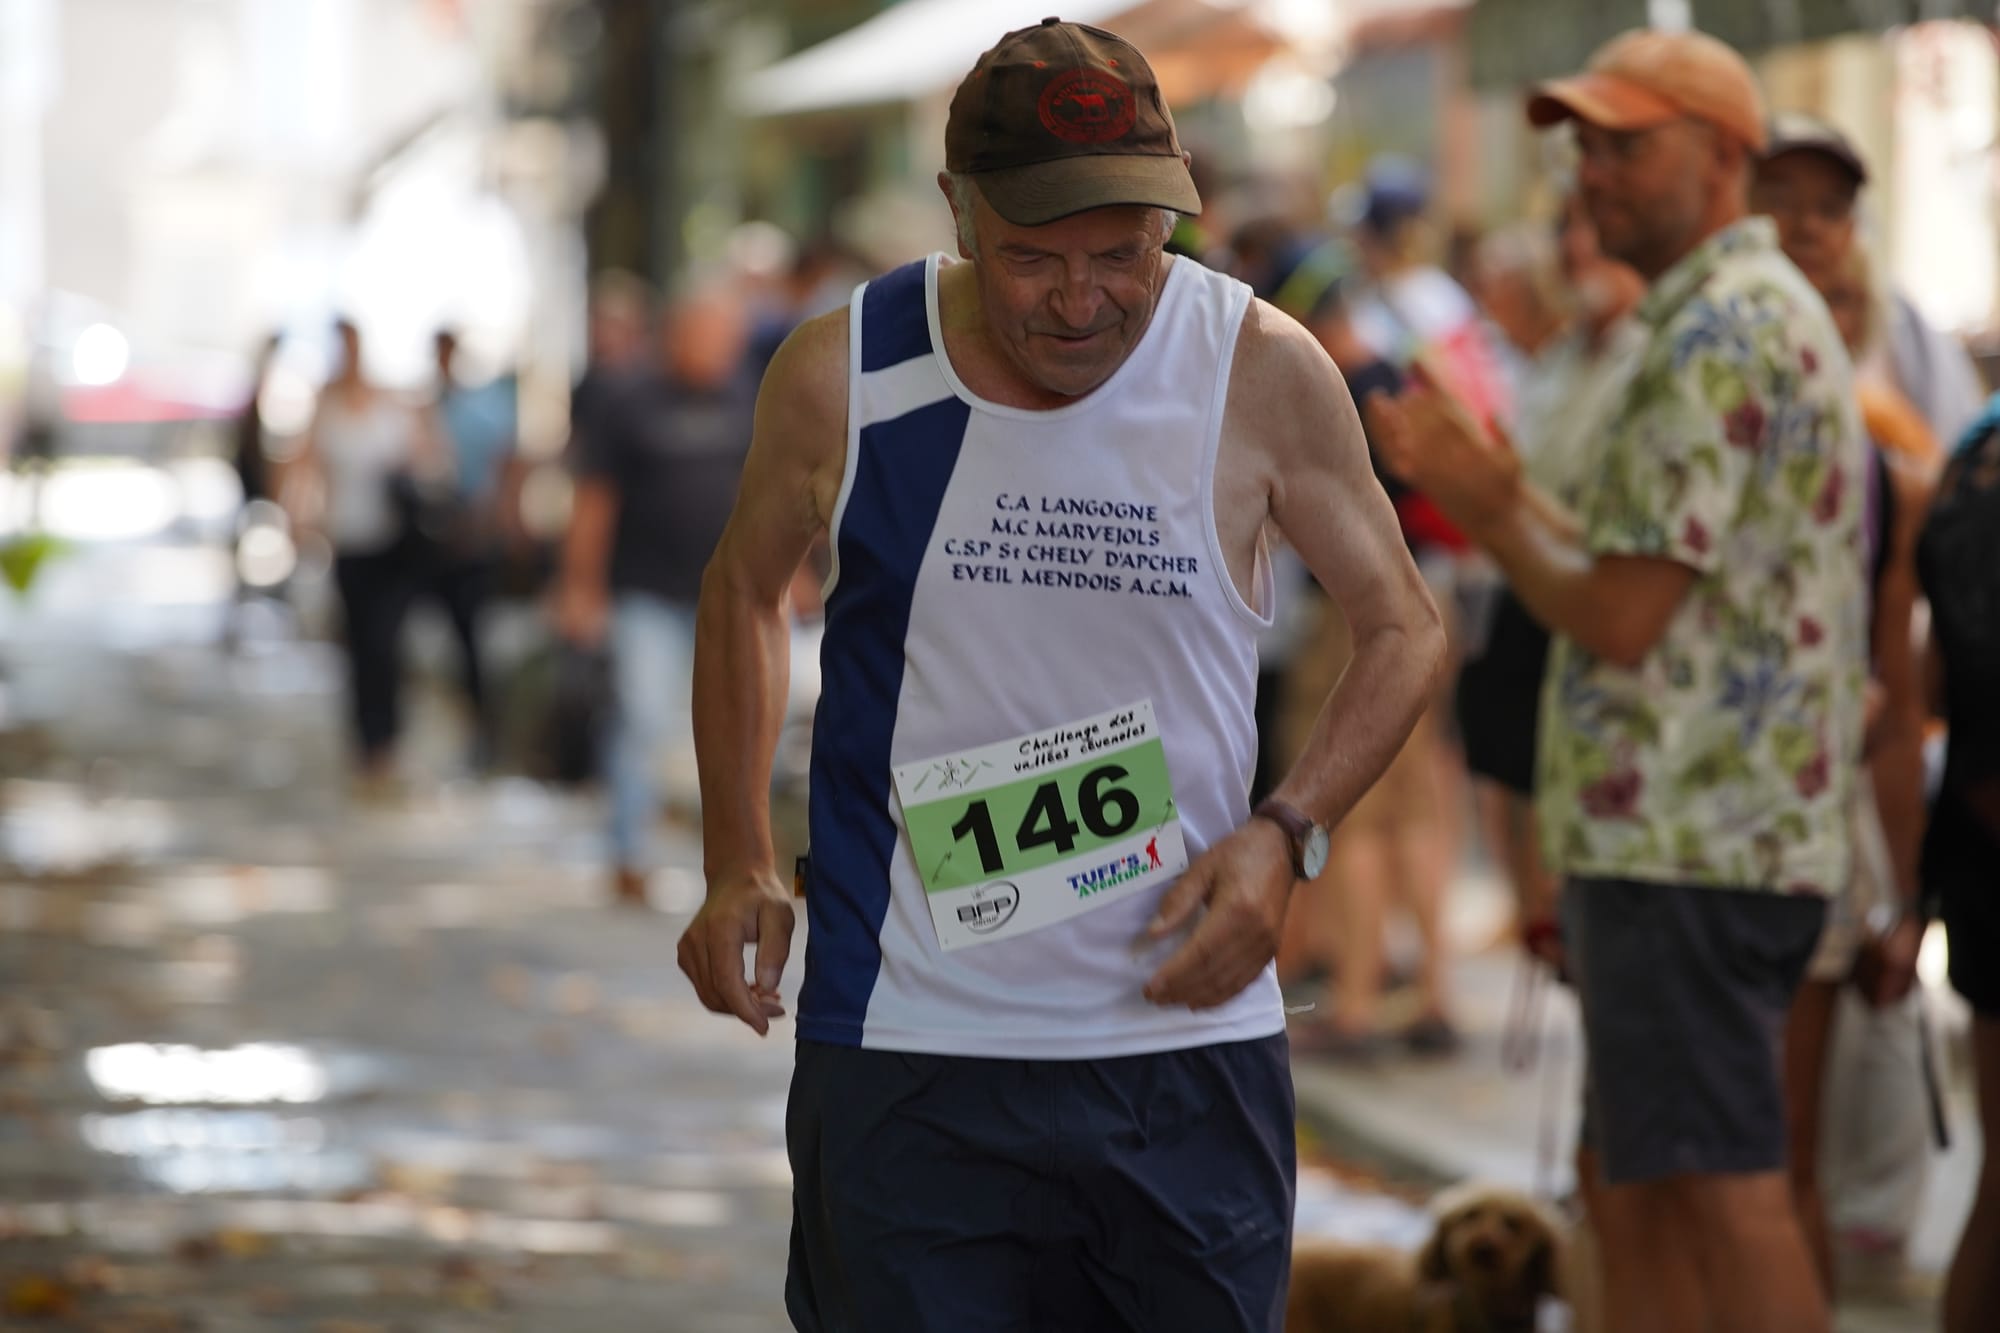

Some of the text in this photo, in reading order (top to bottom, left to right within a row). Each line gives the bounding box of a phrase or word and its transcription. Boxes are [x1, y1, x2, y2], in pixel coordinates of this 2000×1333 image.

[996, 493, 1158, 522] C.A LANGOGNE
[991, 518, 1160, 546] M.C MARVEJOLS
[999, 542, 1020, 559] St
[1027, 544, 1094, 565] CHELY
[1105, 551, 1198, 574] D'APCHER
[952, 564, 1193, 599] EVEIL MENDOIS A.C.M.
[1019, 710, 1134, 755] Challenge des
[1013, 747, 1070, 773] vallées
[951, 764, 1140, 875] 146
[1067, 853, 1140, 890] TUFF'S
